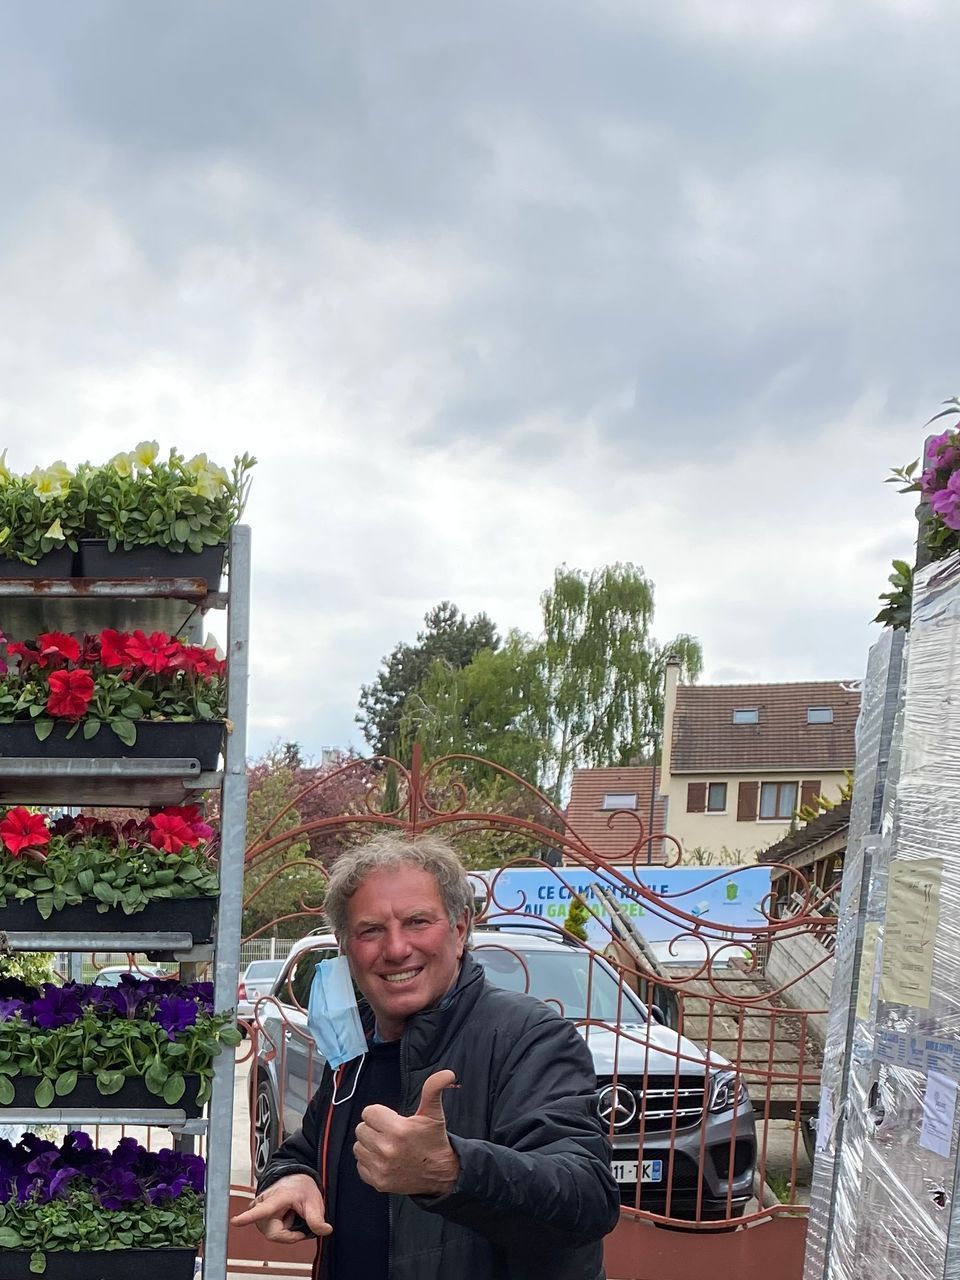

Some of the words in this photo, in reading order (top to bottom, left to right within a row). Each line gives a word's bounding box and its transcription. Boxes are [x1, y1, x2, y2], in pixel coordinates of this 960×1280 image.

[538, 886, 555, 900] CE
[558, 885, 617, 900] CAMIN
[620, 884, 669, 900] ROLE
[524, 904, 543, 917] AU
